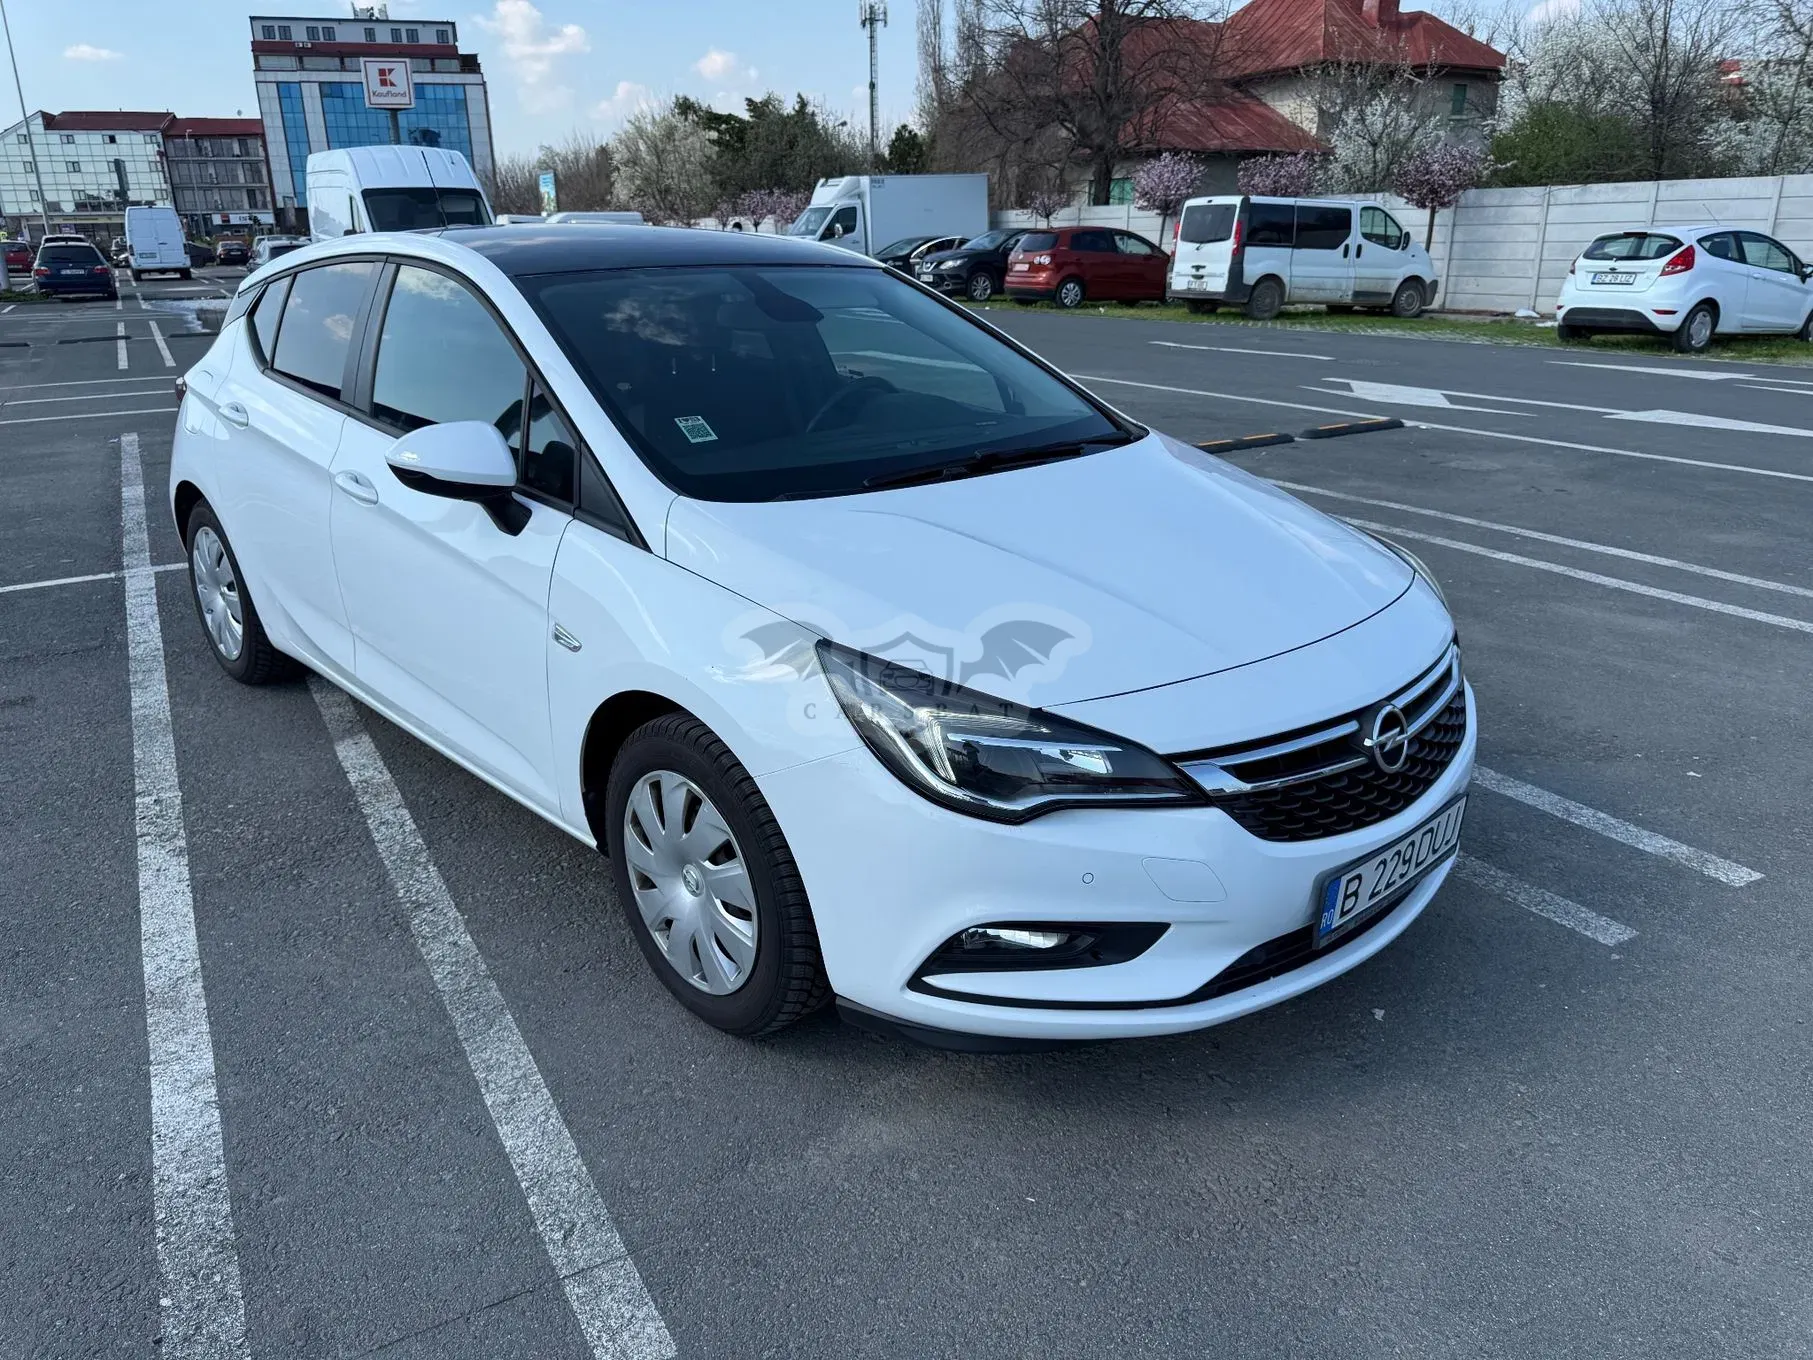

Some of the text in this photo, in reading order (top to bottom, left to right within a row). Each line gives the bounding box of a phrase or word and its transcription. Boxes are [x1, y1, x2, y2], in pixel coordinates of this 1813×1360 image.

[372, 90, 407, 98] Kaufland
[1339, 872, 1363, 920] B
[1320, 909, 1335, 929] RO
